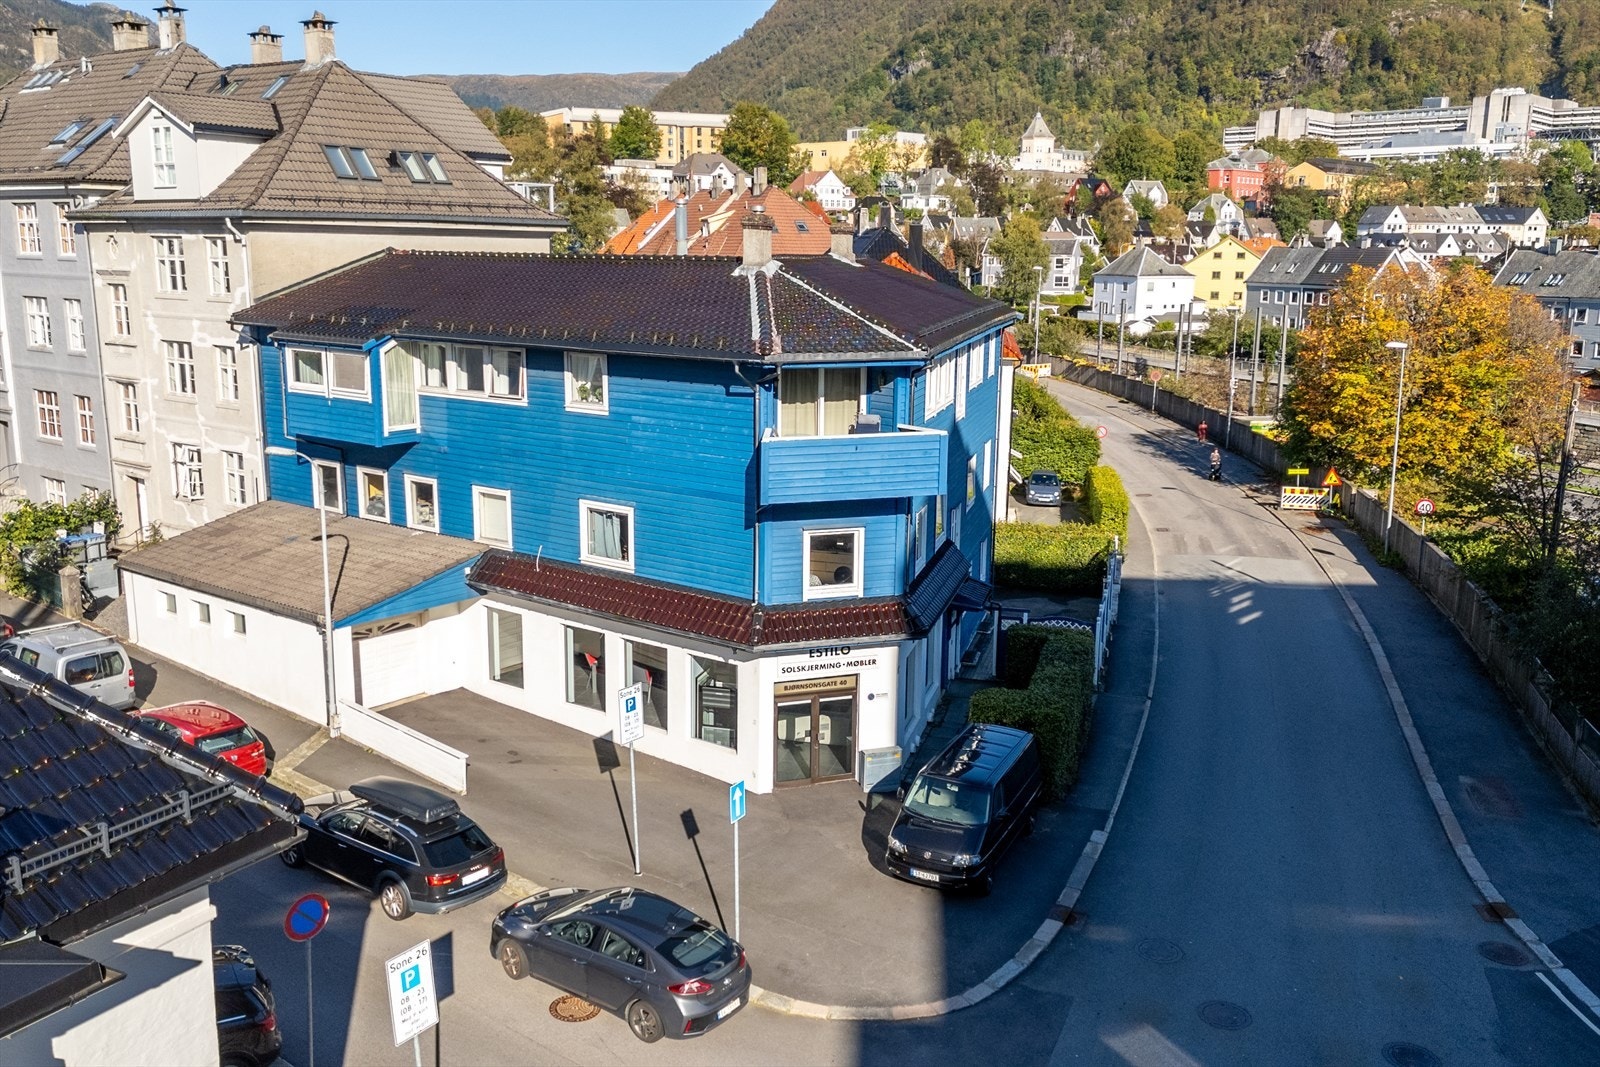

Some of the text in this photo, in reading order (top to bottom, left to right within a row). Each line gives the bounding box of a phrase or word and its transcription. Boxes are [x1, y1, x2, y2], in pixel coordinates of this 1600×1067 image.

[809, 646, 851, 658] ESTILO
[781, 659, 877, 674] SOLSKJERMING MØBLER
[784, 681, 837, 691] BJØRNSONSGATE
[389, 947, 428, 973] Sone 26
[400, 996, 410, 1005] 08
